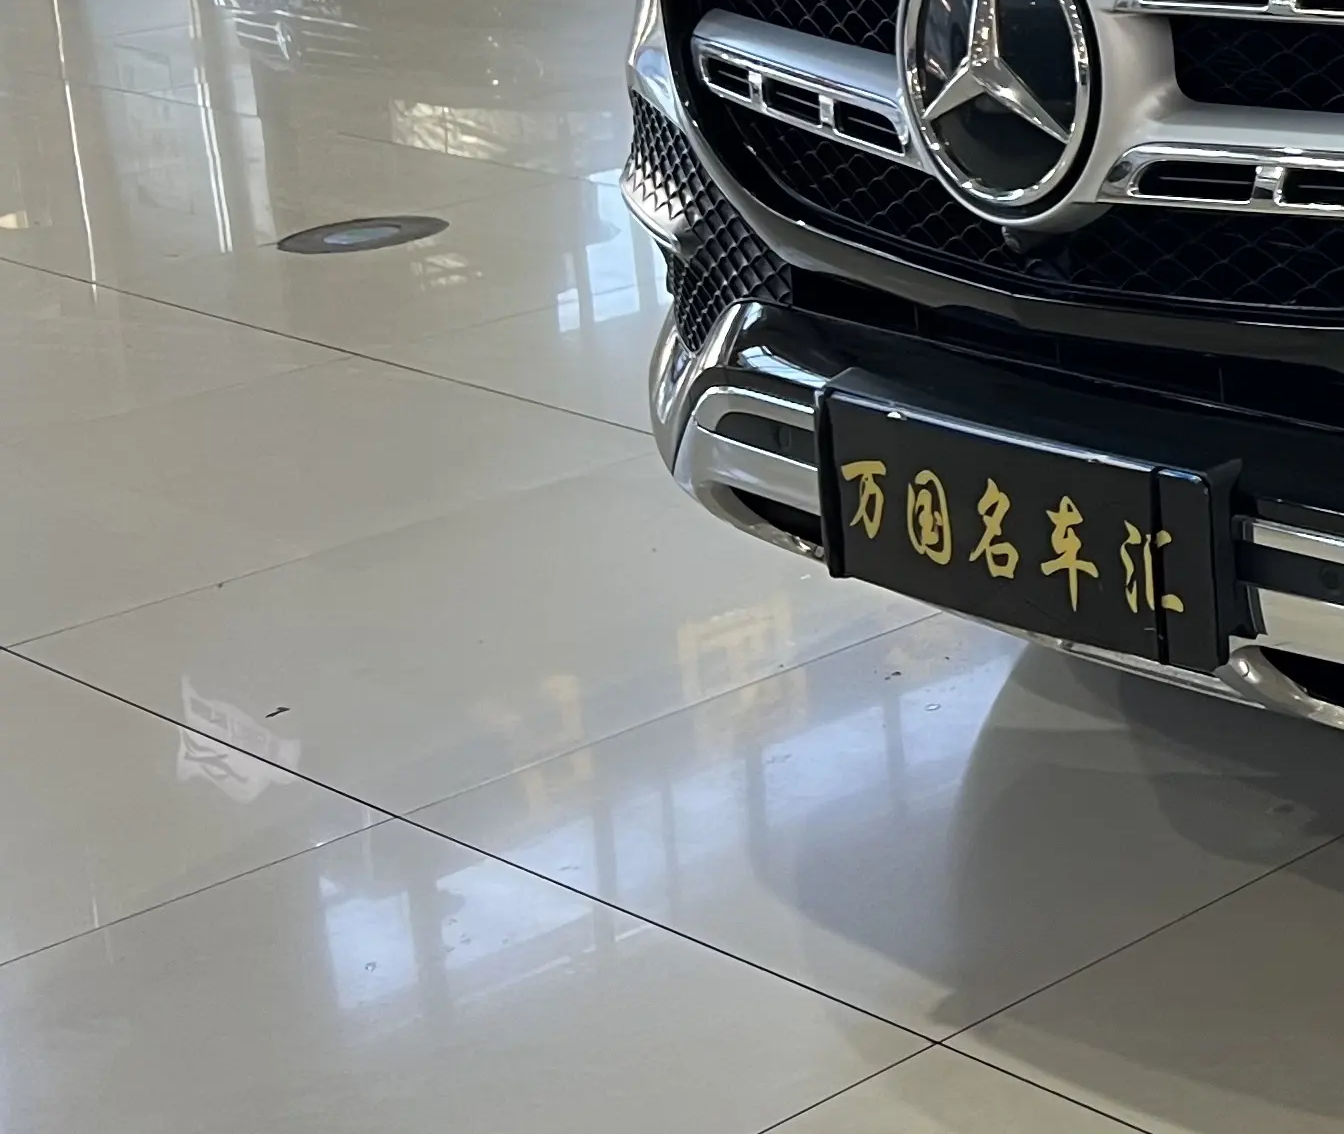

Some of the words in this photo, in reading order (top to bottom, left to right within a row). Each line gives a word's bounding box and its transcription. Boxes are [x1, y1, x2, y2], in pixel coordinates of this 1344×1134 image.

[840, 459, 1185, 615] 万国名车汇
